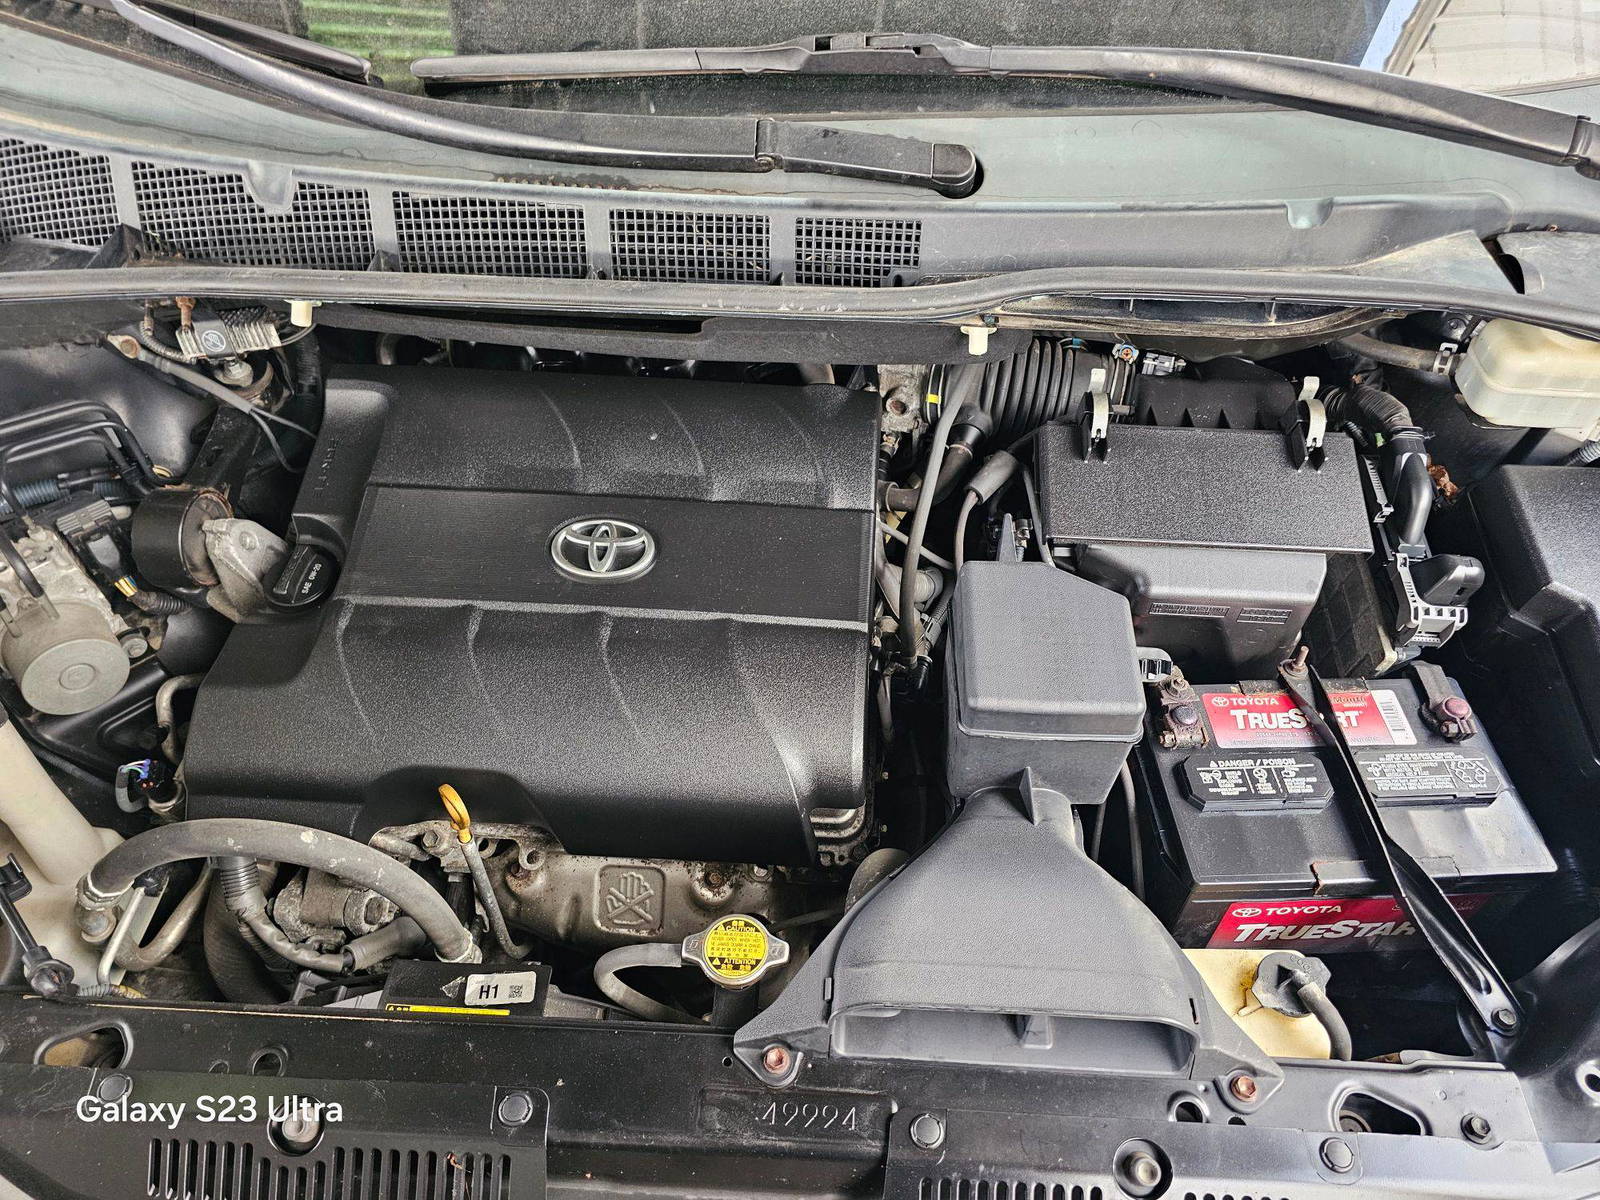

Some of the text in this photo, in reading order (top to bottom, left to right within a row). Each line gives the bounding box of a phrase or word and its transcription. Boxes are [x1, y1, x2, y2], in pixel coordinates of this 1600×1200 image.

[301, 563, 322, 594] SAE 0W-20
[1232, 697, 1279, 706] TOYOTA
[1218, 759, 1254, 767] DANGER
[1262, 757, 1296, 766] POISON
[1266, 905, 1342, 916] TOYOTA
[478, 984, 499, 999] H1
